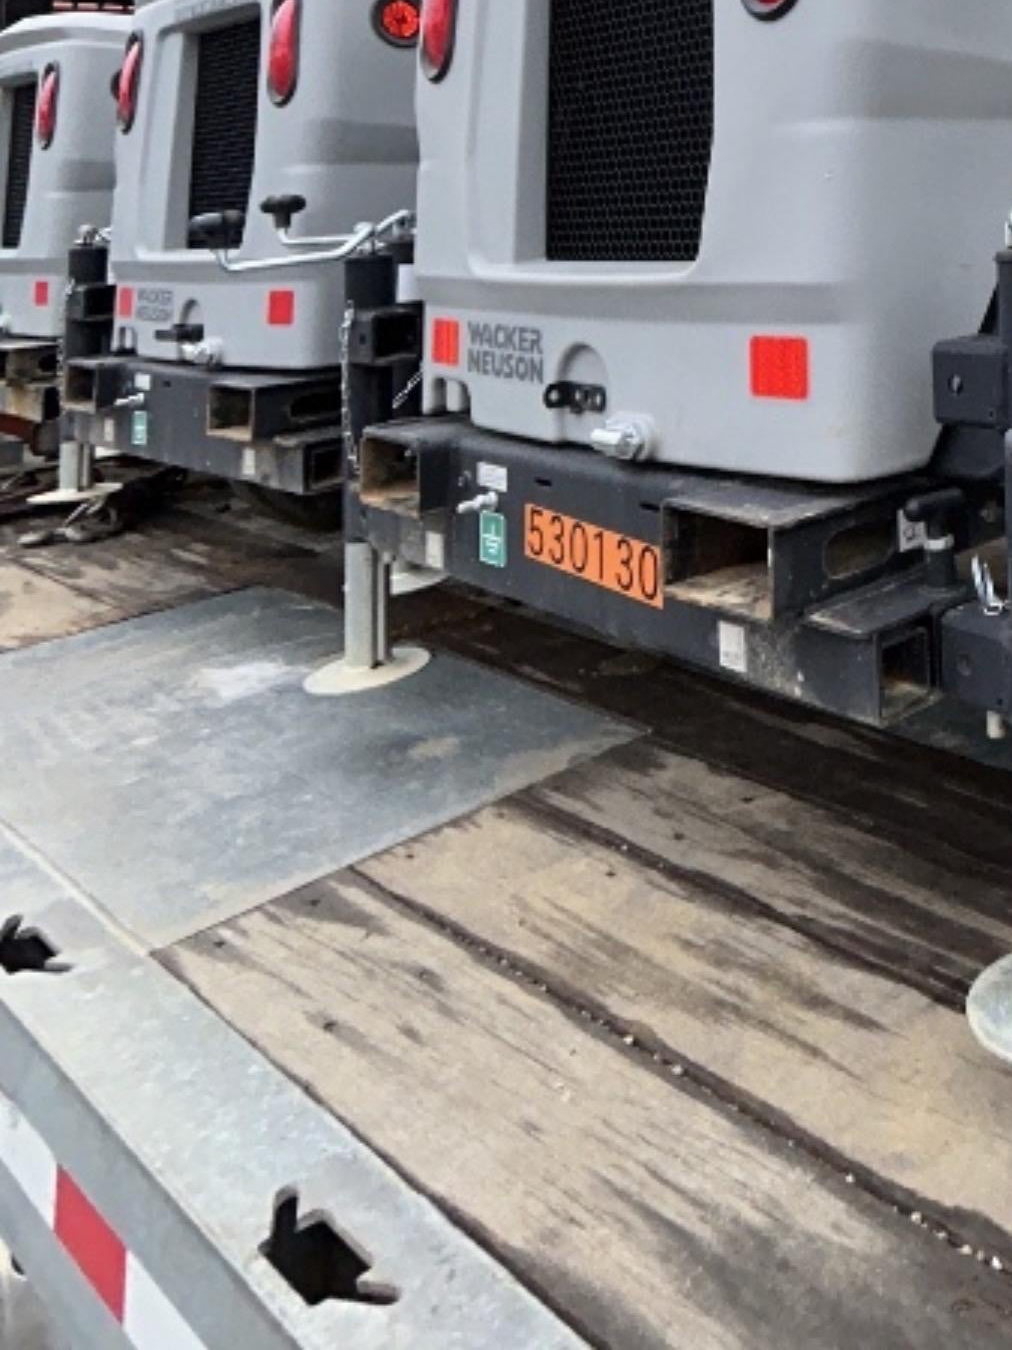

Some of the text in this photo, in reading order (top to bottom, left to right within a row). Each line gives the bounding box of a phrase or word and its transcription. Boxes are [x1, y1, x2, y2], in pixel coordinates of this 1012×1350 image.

[466, 320, 544, 355] WACKER
[466, 347, 544, 385] NEUSON
[527, 506, 660, 601] 530130
